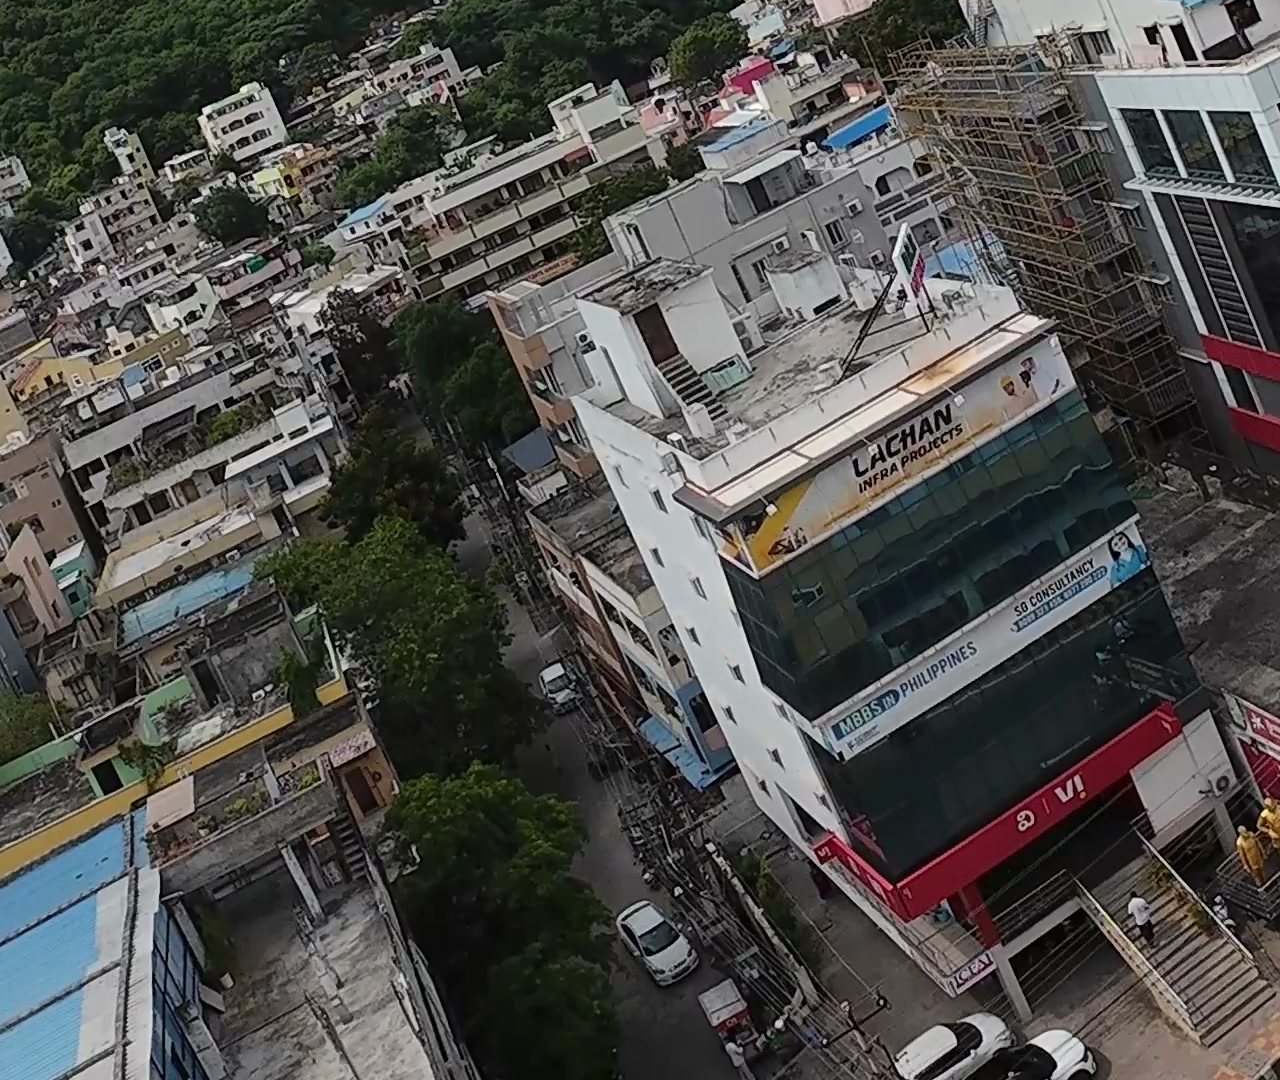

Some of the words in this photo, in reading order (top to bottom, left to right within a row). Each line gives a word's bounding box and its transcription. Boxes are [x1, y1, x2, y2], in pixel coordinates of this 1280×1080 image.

[852, 403, 953, 478] LACHAN
[858, 462, 899, 494] INFRA
[901, 422, 964, 468] PROJECTS
[1028, 557, 1095, 607] CONSULTANCY
[839, 700, 883, 736] MBBS
[883, 695, 897, 710] IN
[899, 641, 978, 698] PHILIPPINES
